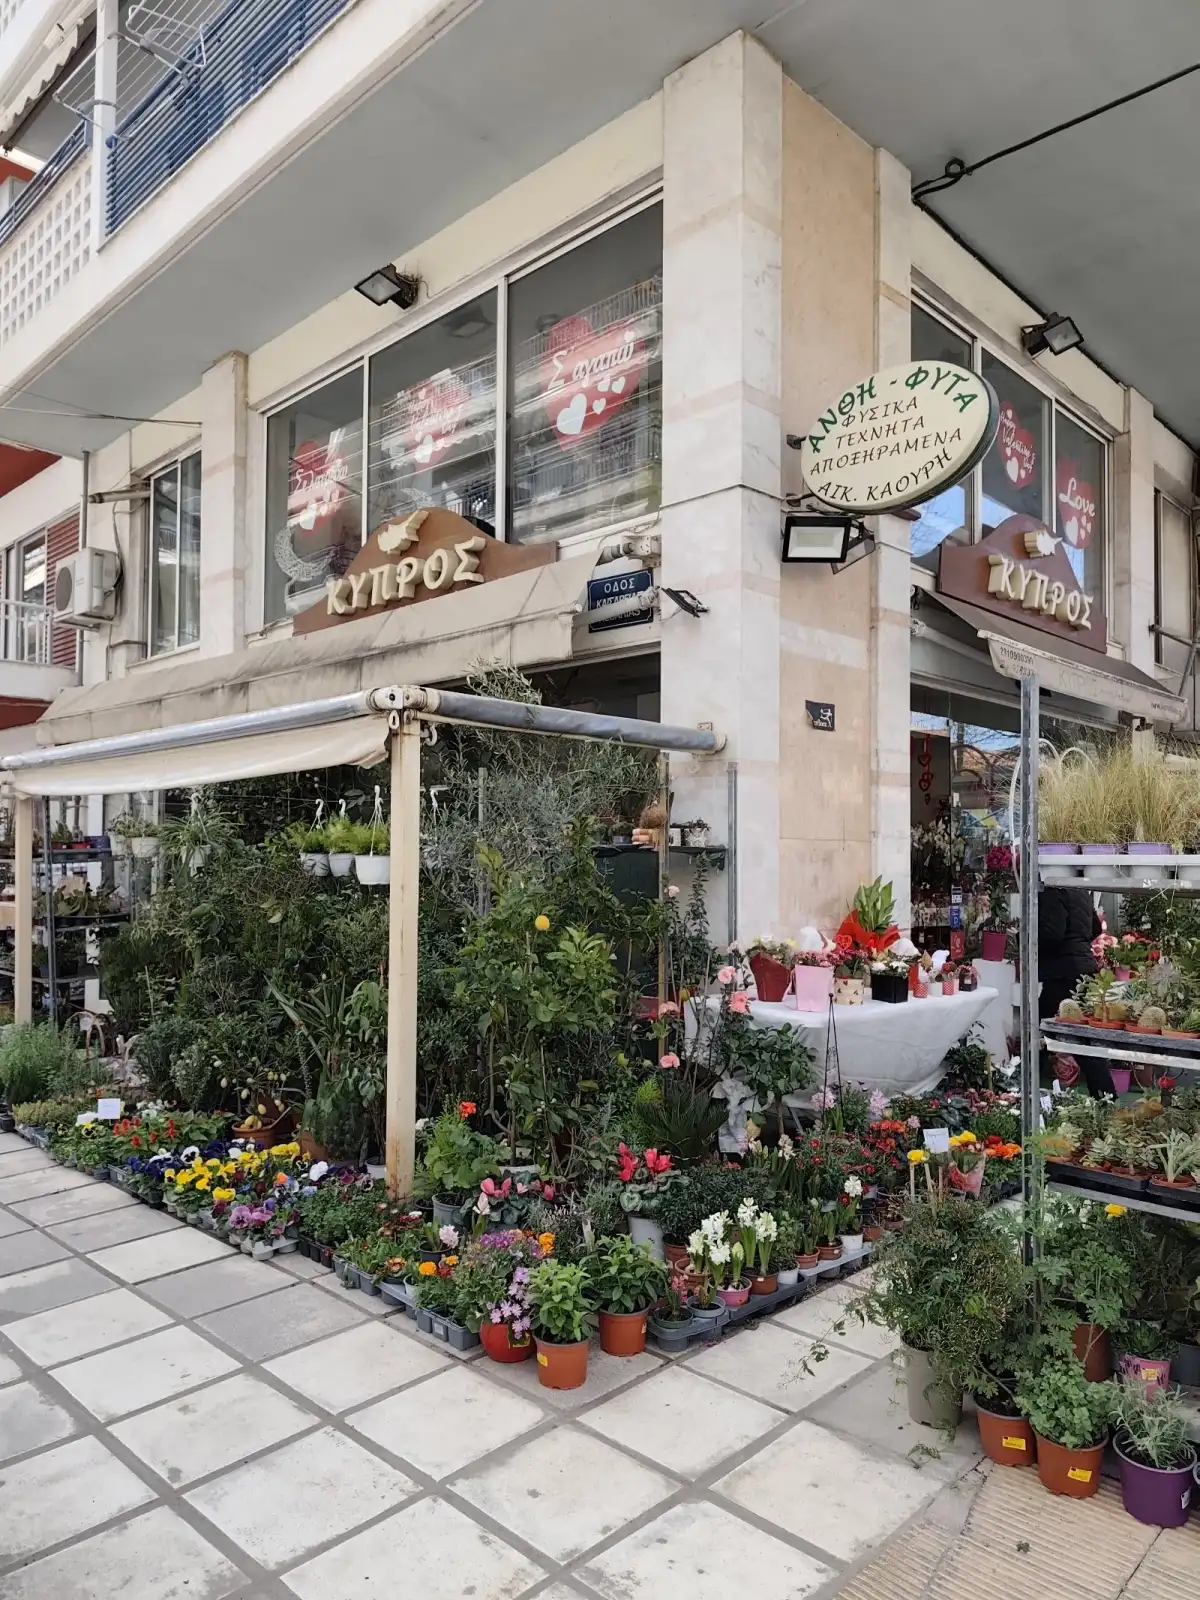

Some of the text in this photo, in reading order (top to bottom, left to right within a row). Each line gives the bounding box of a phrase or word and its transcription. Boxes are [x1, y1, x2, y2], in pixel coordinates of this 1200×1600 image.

[808, 375, 877, 454] ΑΝΘΗ
[905, 366, 979, 413] ΦΥΤΑ
[836, 415, 925, 449] ΤΕΧΝΗΤΑ
[841, 396, 918, 428] ΦΥΣΙΚΑ
[810, 428, 962, 476] ΑΠΟΞΗΡΑΜΕΝΑ
[817, 447, 952, 502] ΑΙΚ. ΚΑΟΥΡΗ
[1060, 477, 1096, 517] Love
[326, 536, 487, 616] ΚΥΠΡΟΣ
[604, 577, 636, 594] ΟΔΟΣ
[992, 553, 1094, 630] ΚΥΠΡΟΣ
